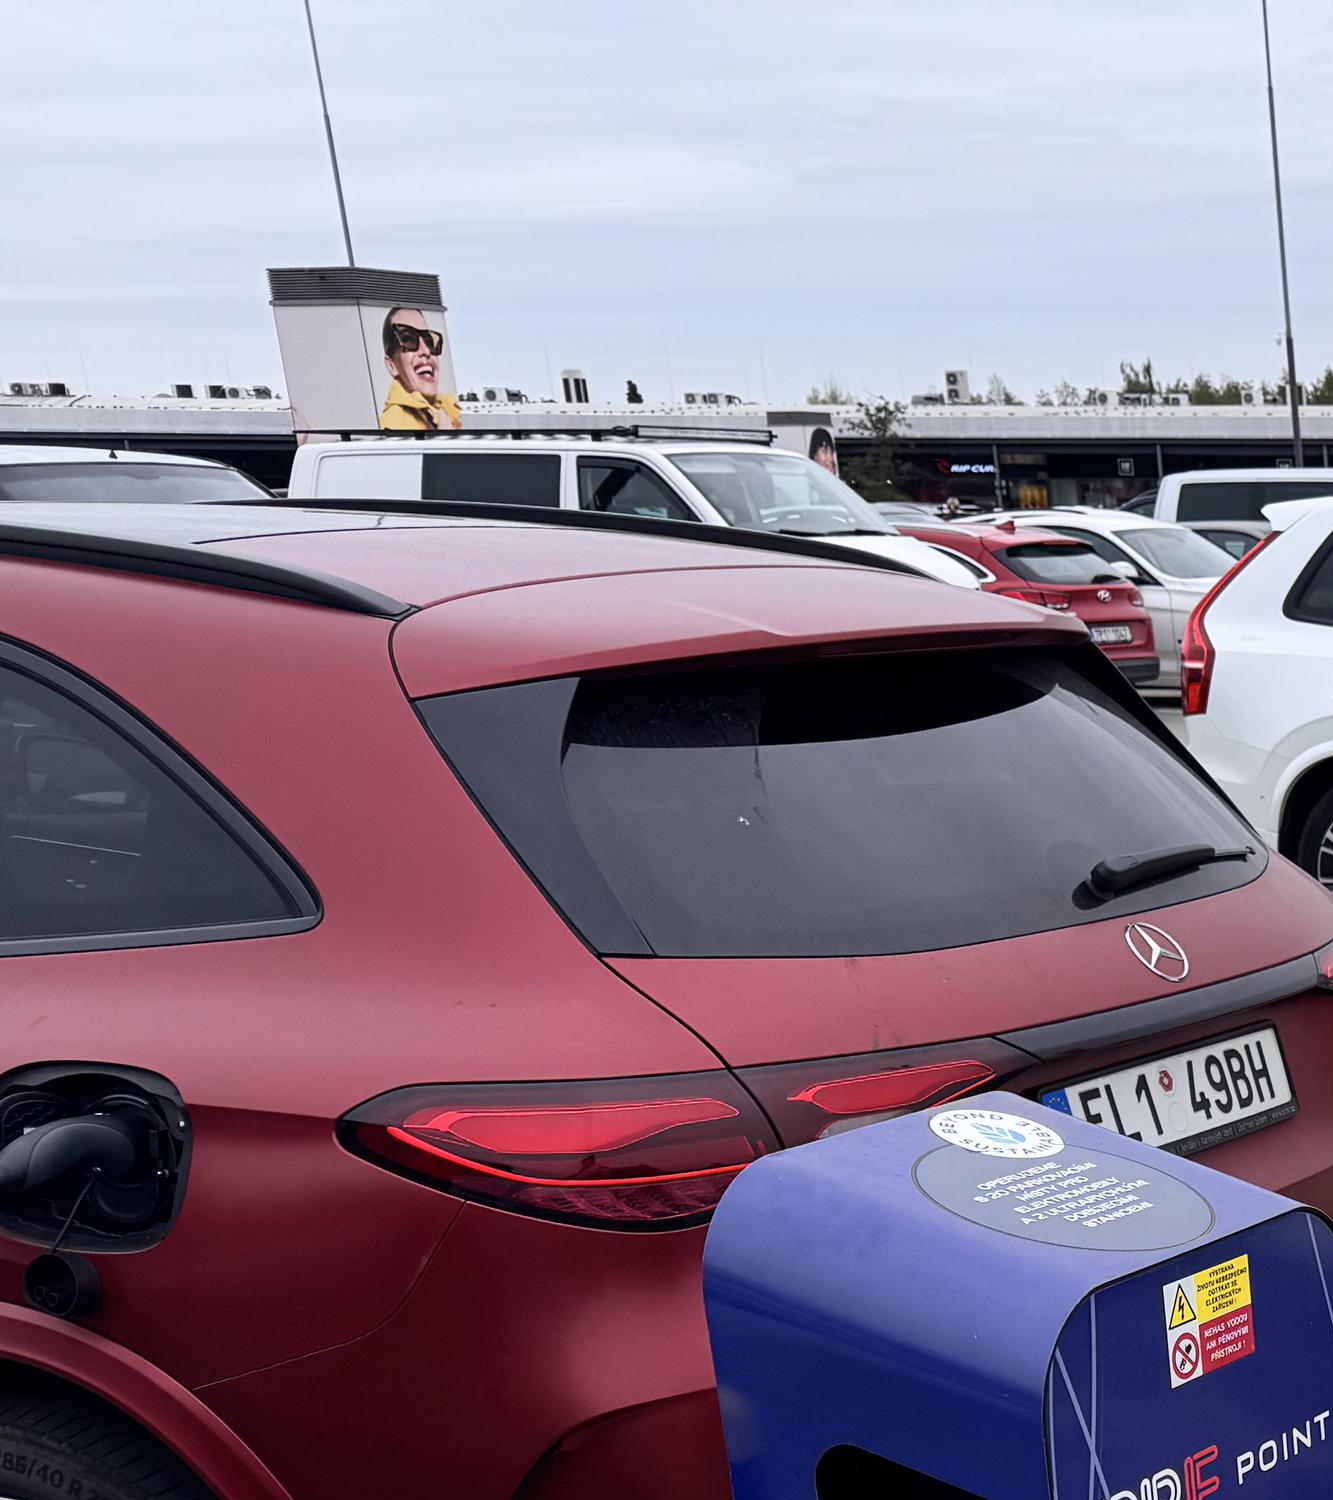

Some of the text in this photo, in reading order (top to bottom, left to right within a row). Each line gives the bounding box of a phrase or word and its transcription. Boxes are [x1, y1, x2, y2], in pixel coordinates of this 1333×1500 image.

[1186, 1041, 1276, 1120] 49BH
[977, 1161, 1062, 1191] OPERUJEME
[1015, 1176, 1089, 1202] MÍSTY PRO
[985, 1190, 1010, 1200] 20
[1014, 1176, 1120, 1215] ELEKTROMOBILY
[1020, 1216, 1038, 1225] A
[1082, 1201, 1155, 1228] STANICEMI
[1204, 1312, 1248, 1339] NEHAS VODOU
[1206, 1340, 1217, 1351] ANI
[1236, 1410, 1330, 1485] POINT
[0, 1450, 65, 1490] 85/40
